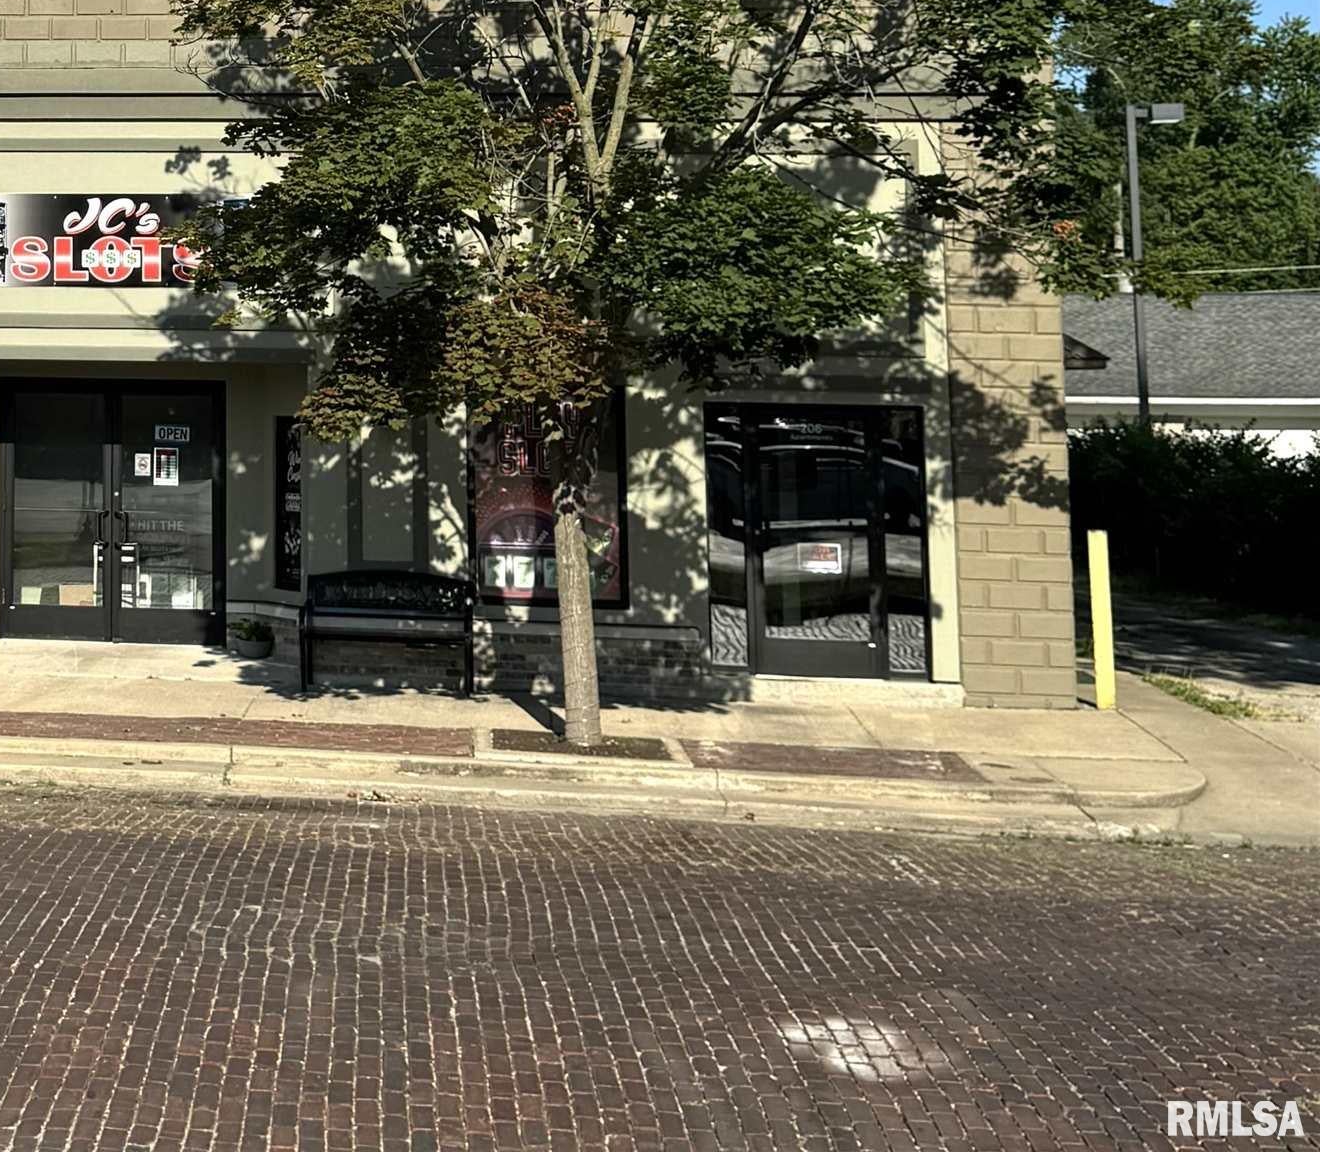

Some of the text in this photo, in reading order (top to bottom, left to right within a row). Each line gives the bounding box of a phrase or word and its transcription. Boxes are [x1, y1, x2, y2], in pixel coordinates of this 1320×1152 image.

[63, 197, 160, 235] JC's
[11, 235, 210, 283] SLOTS
[159, 427, 188, 440] OPEN
